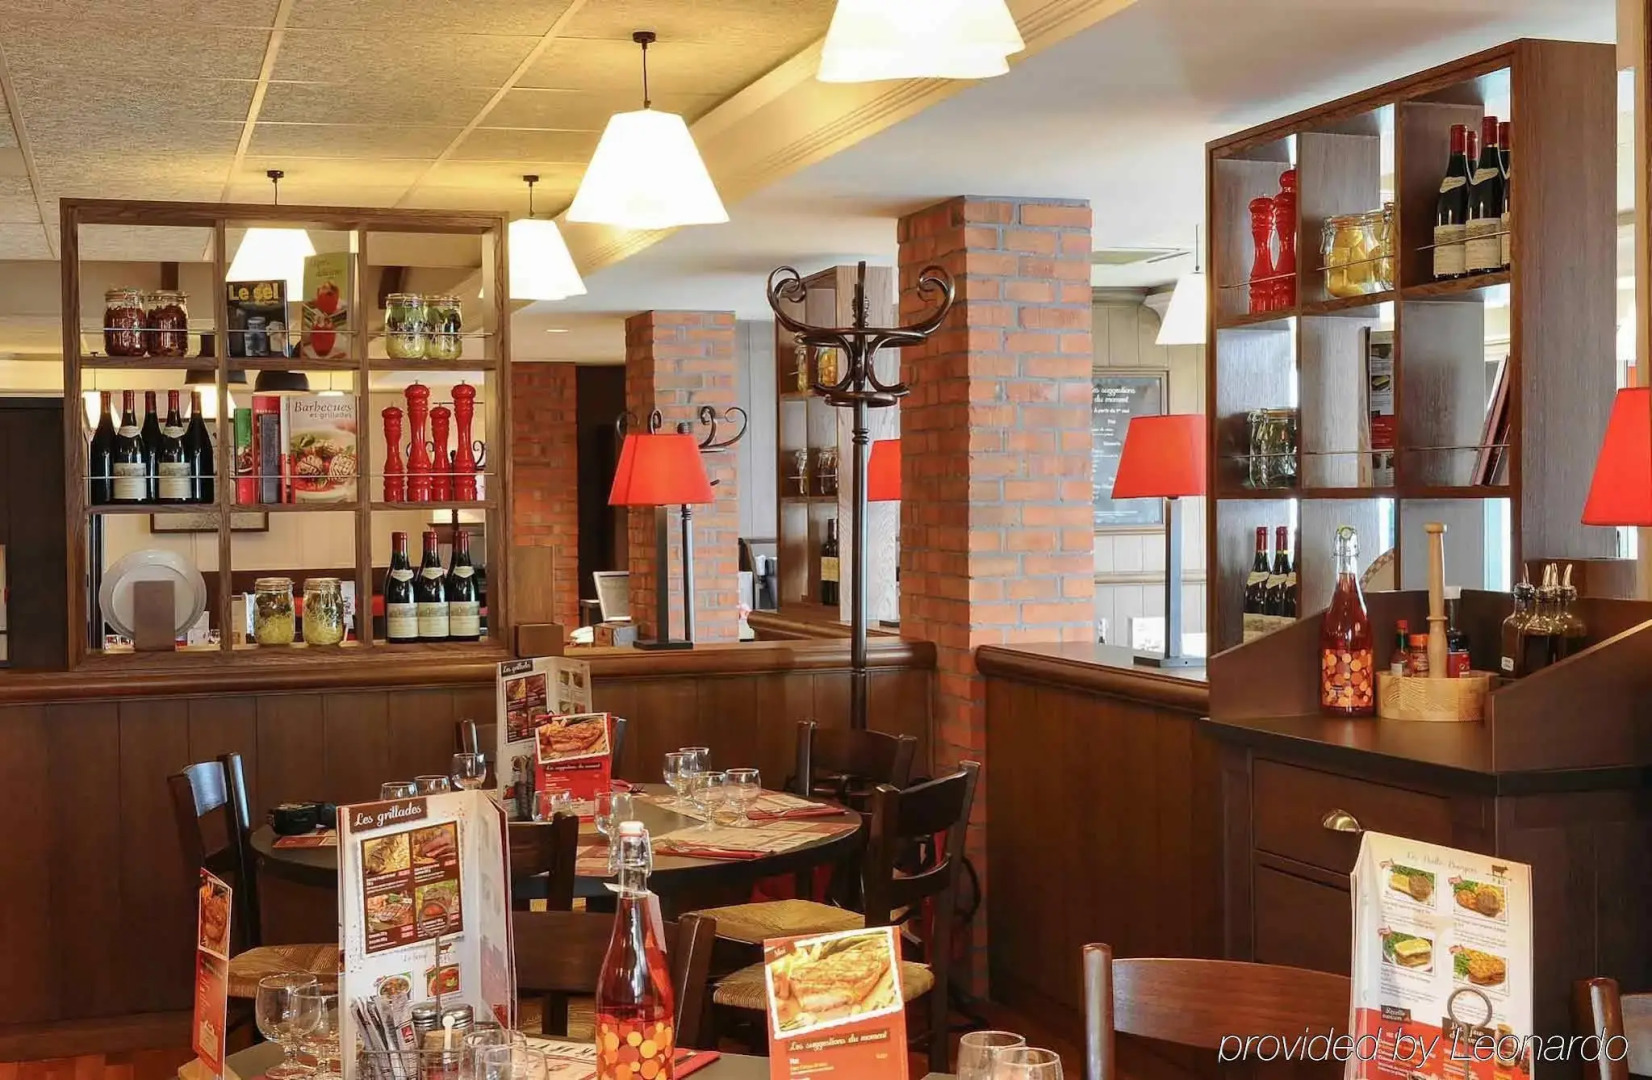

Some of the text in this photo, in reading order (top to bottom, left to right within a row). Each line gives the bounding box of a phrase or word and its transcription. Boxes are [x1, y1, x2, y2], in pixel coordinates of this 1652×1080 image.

[228, 284, 249, 301] Le
[1101, 387, 1136, 396] suggestions
[1094, 394, 1103, 403] du
[294, 401, 352, 413] Barbecues
[320, 411, 352, 419] grillades
[502, 665, 512, 674] Les
[354, 802, 422, 828] Les grillades
[789, 1031, 888, 1052] Les suggestions du moment
